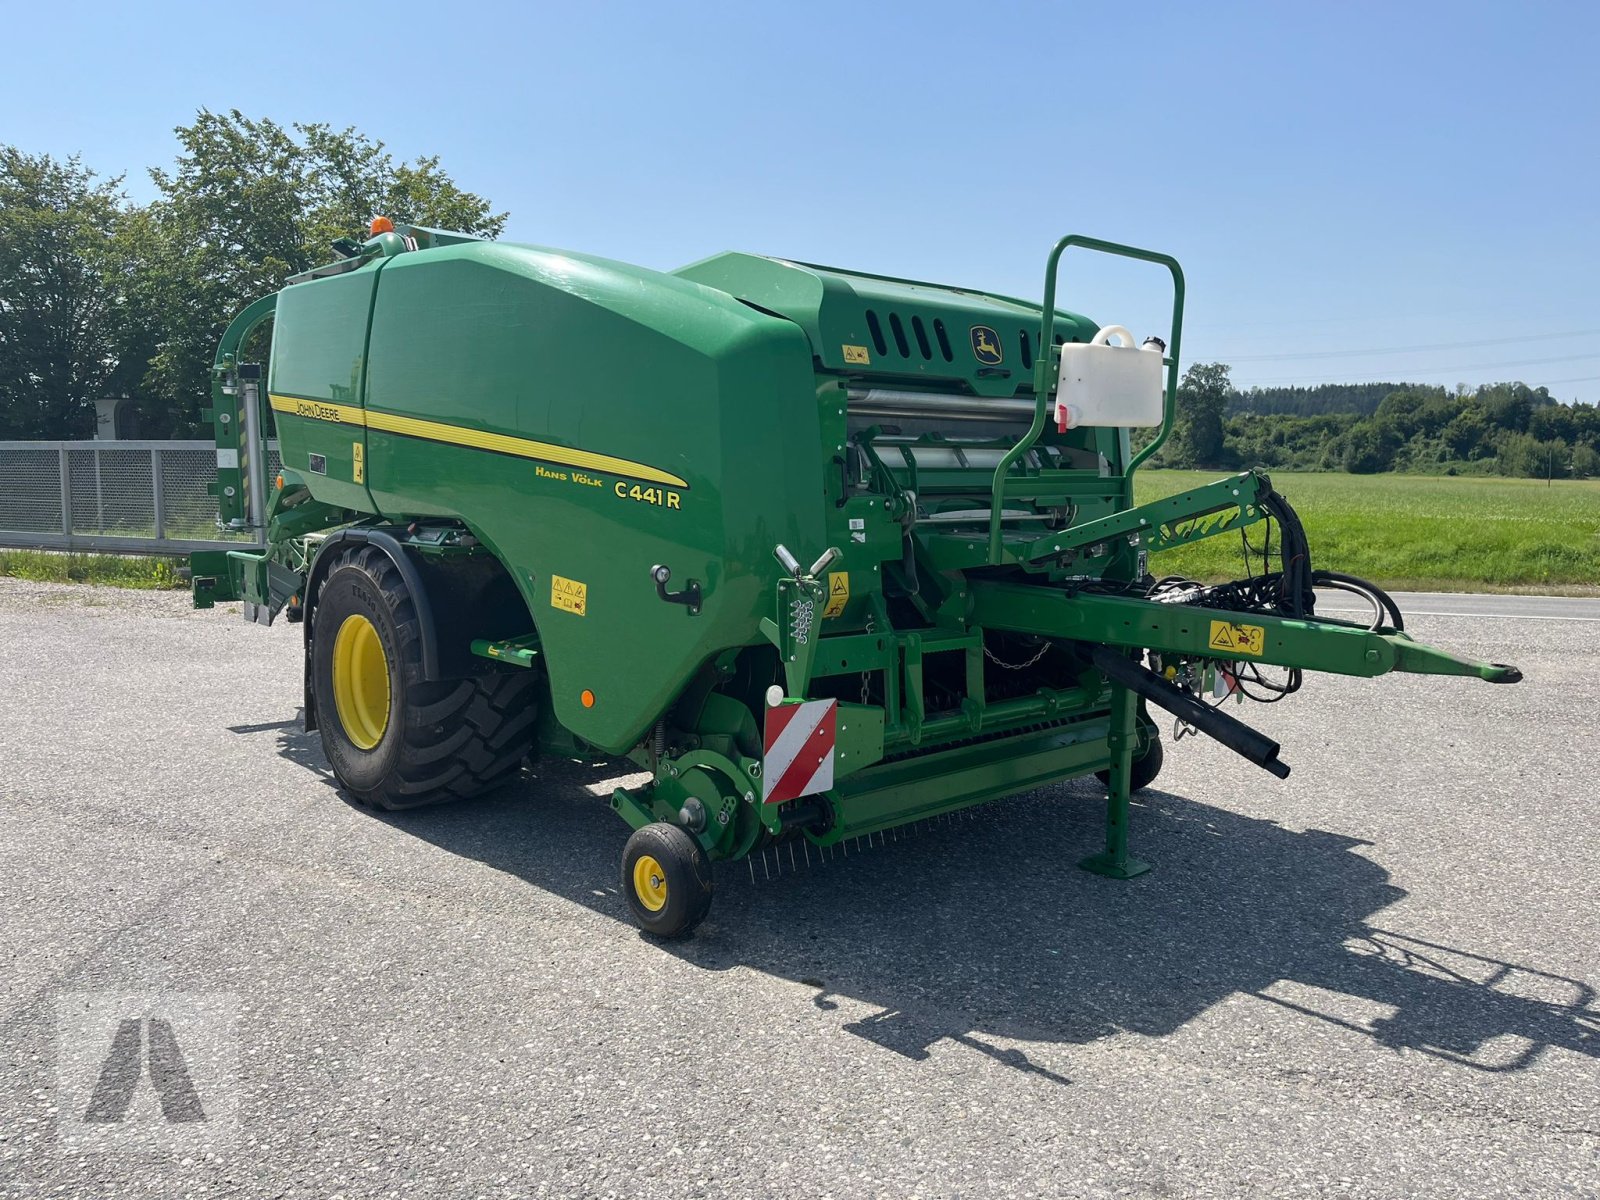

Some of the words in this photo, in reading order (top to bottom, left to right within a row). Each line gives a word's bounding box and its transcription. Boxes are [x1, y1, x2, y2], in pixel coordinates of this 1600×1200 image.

[296, 400, 314, 418] JOHN
[313, 404, 340, 422] DEERE
[535, 466, 567, 481] HANS
